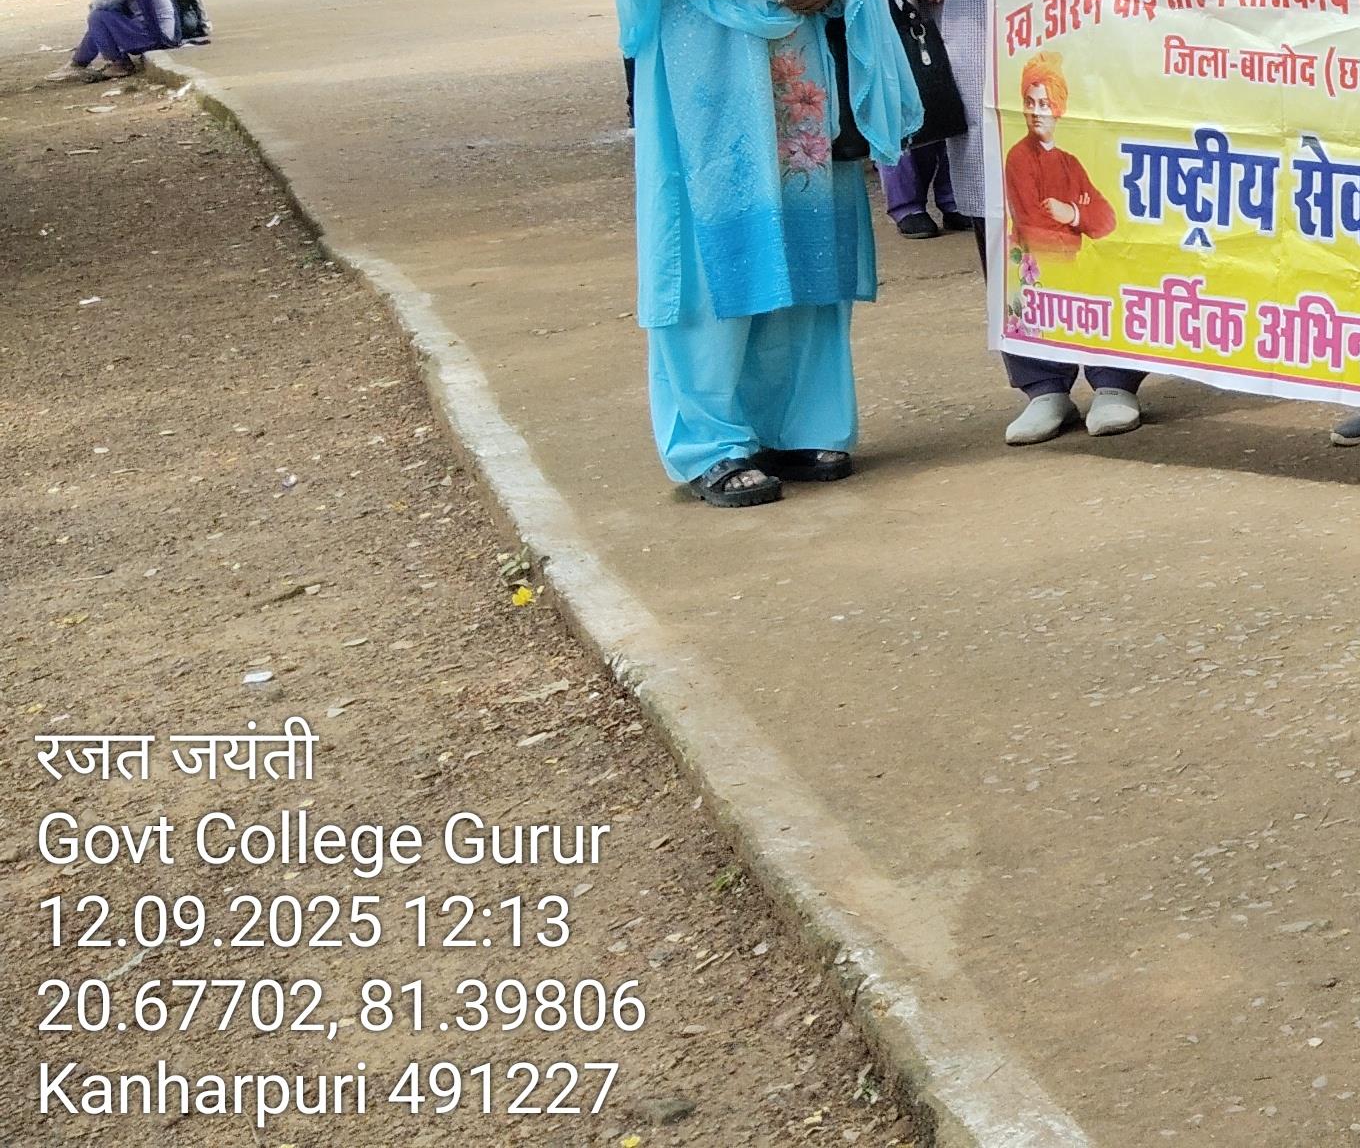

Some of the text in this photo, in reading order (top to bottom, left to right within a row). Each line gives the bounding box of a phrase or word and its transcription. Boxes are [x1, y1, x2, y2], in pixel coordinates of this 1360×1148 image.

[1120, 127, 1280, 248] राष्ट्रीय
[1022, 288, 1112, 337] आपका
[1121, 277, 1246, 353] हार्दिक
